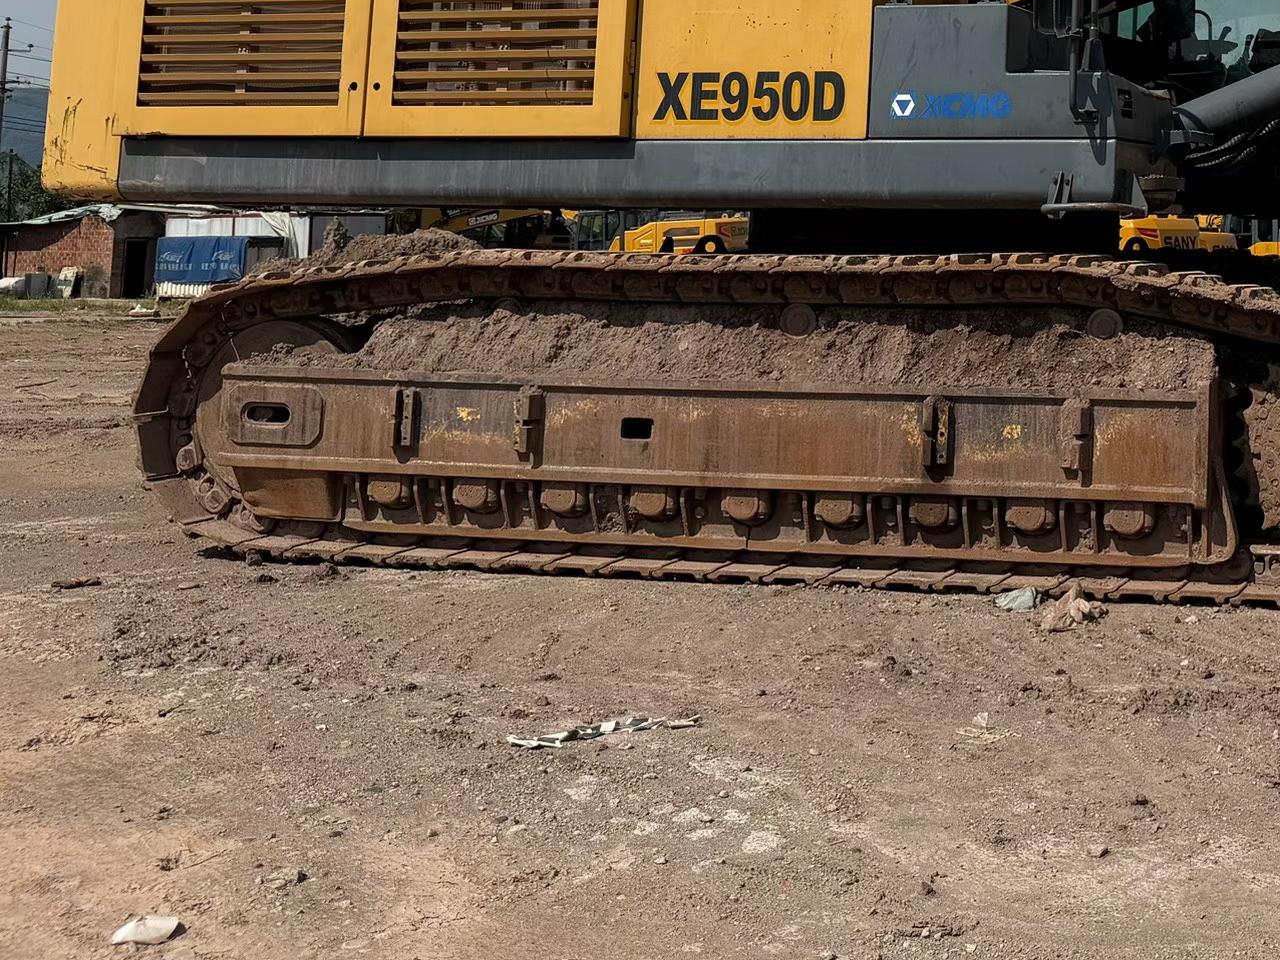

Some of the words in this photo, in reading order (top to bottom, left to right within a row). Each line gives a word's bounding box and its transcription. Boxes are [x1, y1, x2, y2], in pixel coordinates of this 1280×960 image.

[652, 70, 846, 123] XE950D
[921, 92, 1013, 119] XCMG
[1163, 235, 1198, 250] SANY
